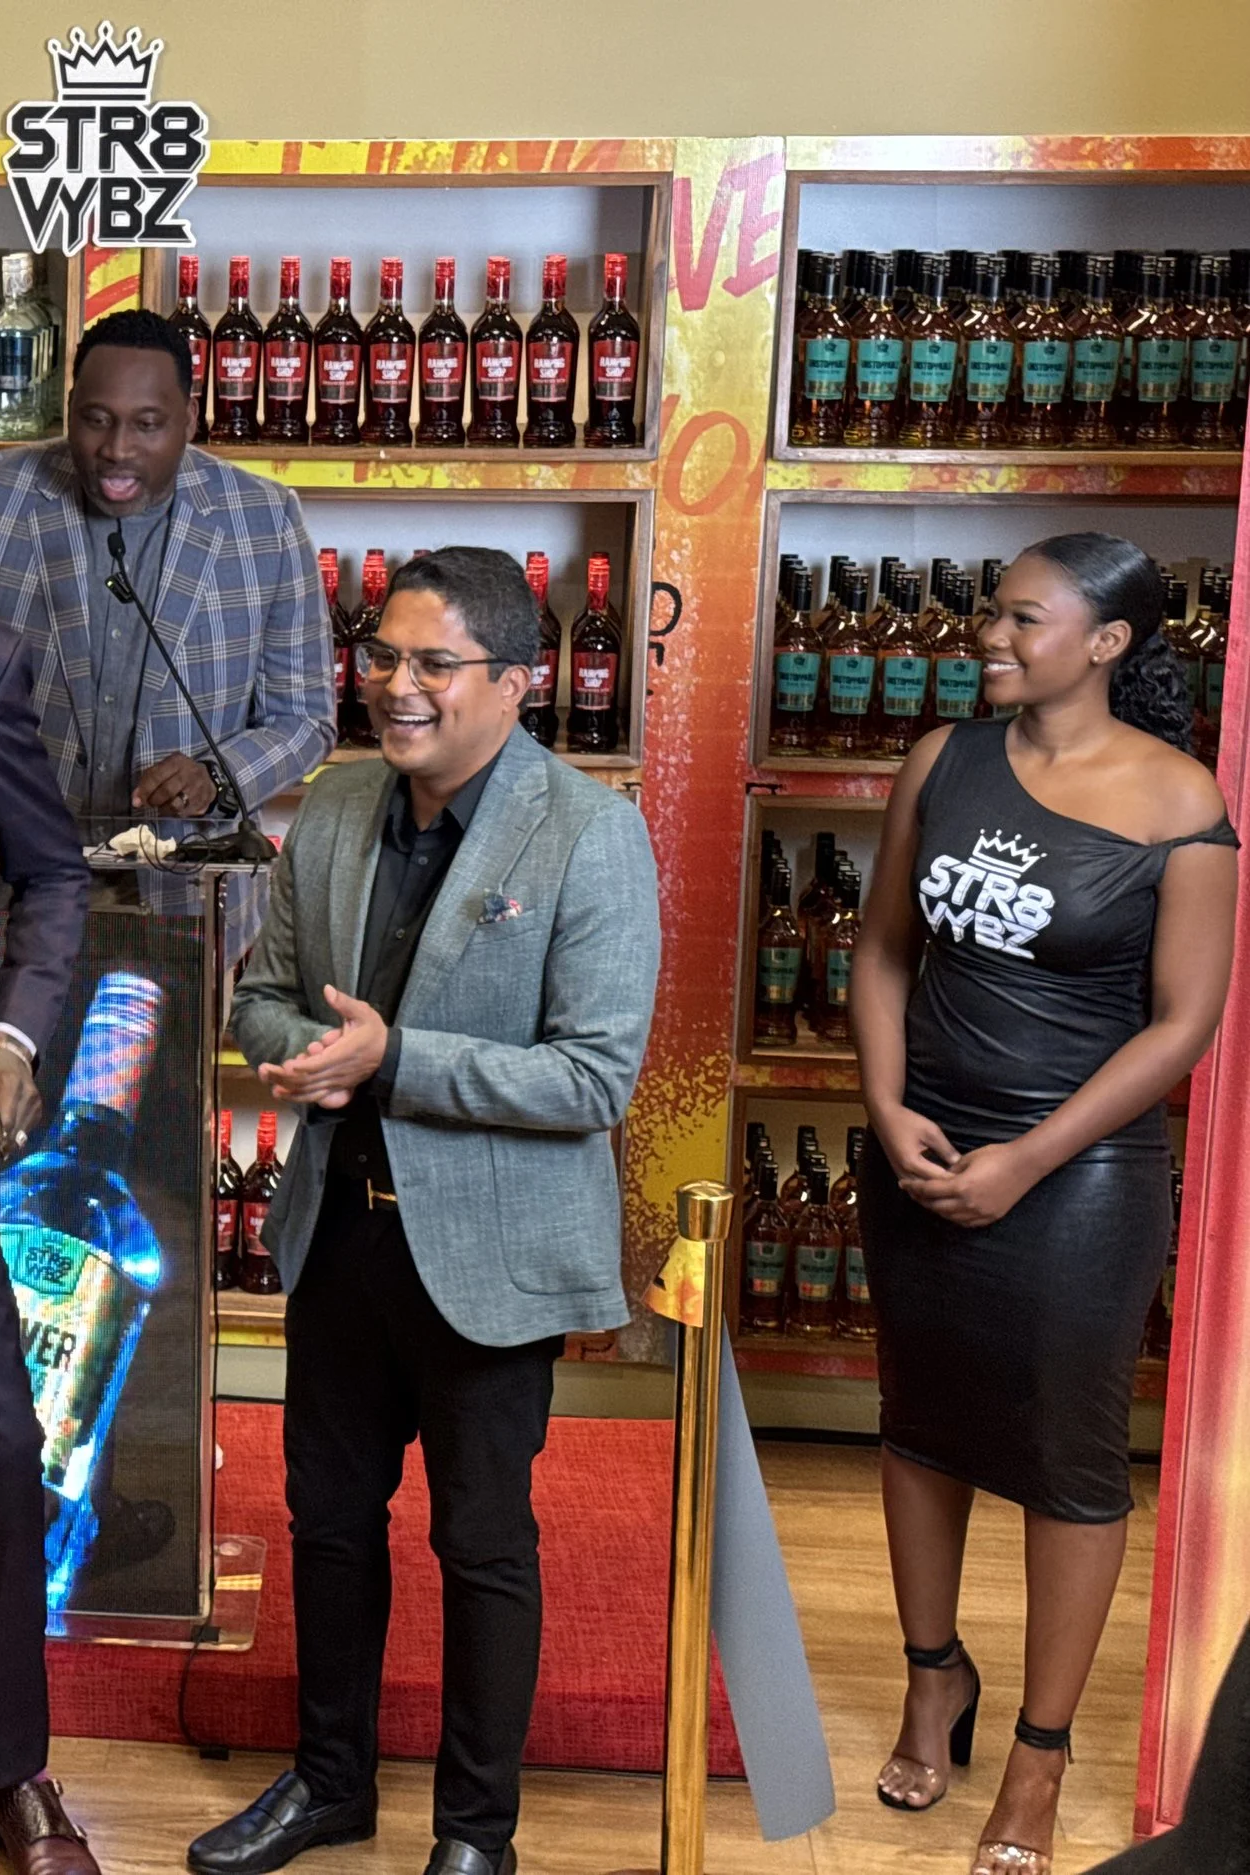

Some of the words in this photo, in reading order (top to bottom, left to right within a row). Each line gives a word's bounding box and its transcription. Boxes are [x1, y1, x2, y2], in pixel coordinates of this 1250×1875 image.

[7, 105, 205, 174] STR8
[11, 176, 194, 253] VYBZ
[918, 891, 1040, 961] VYBZ
[919, 854, 1056, 932] STR8
